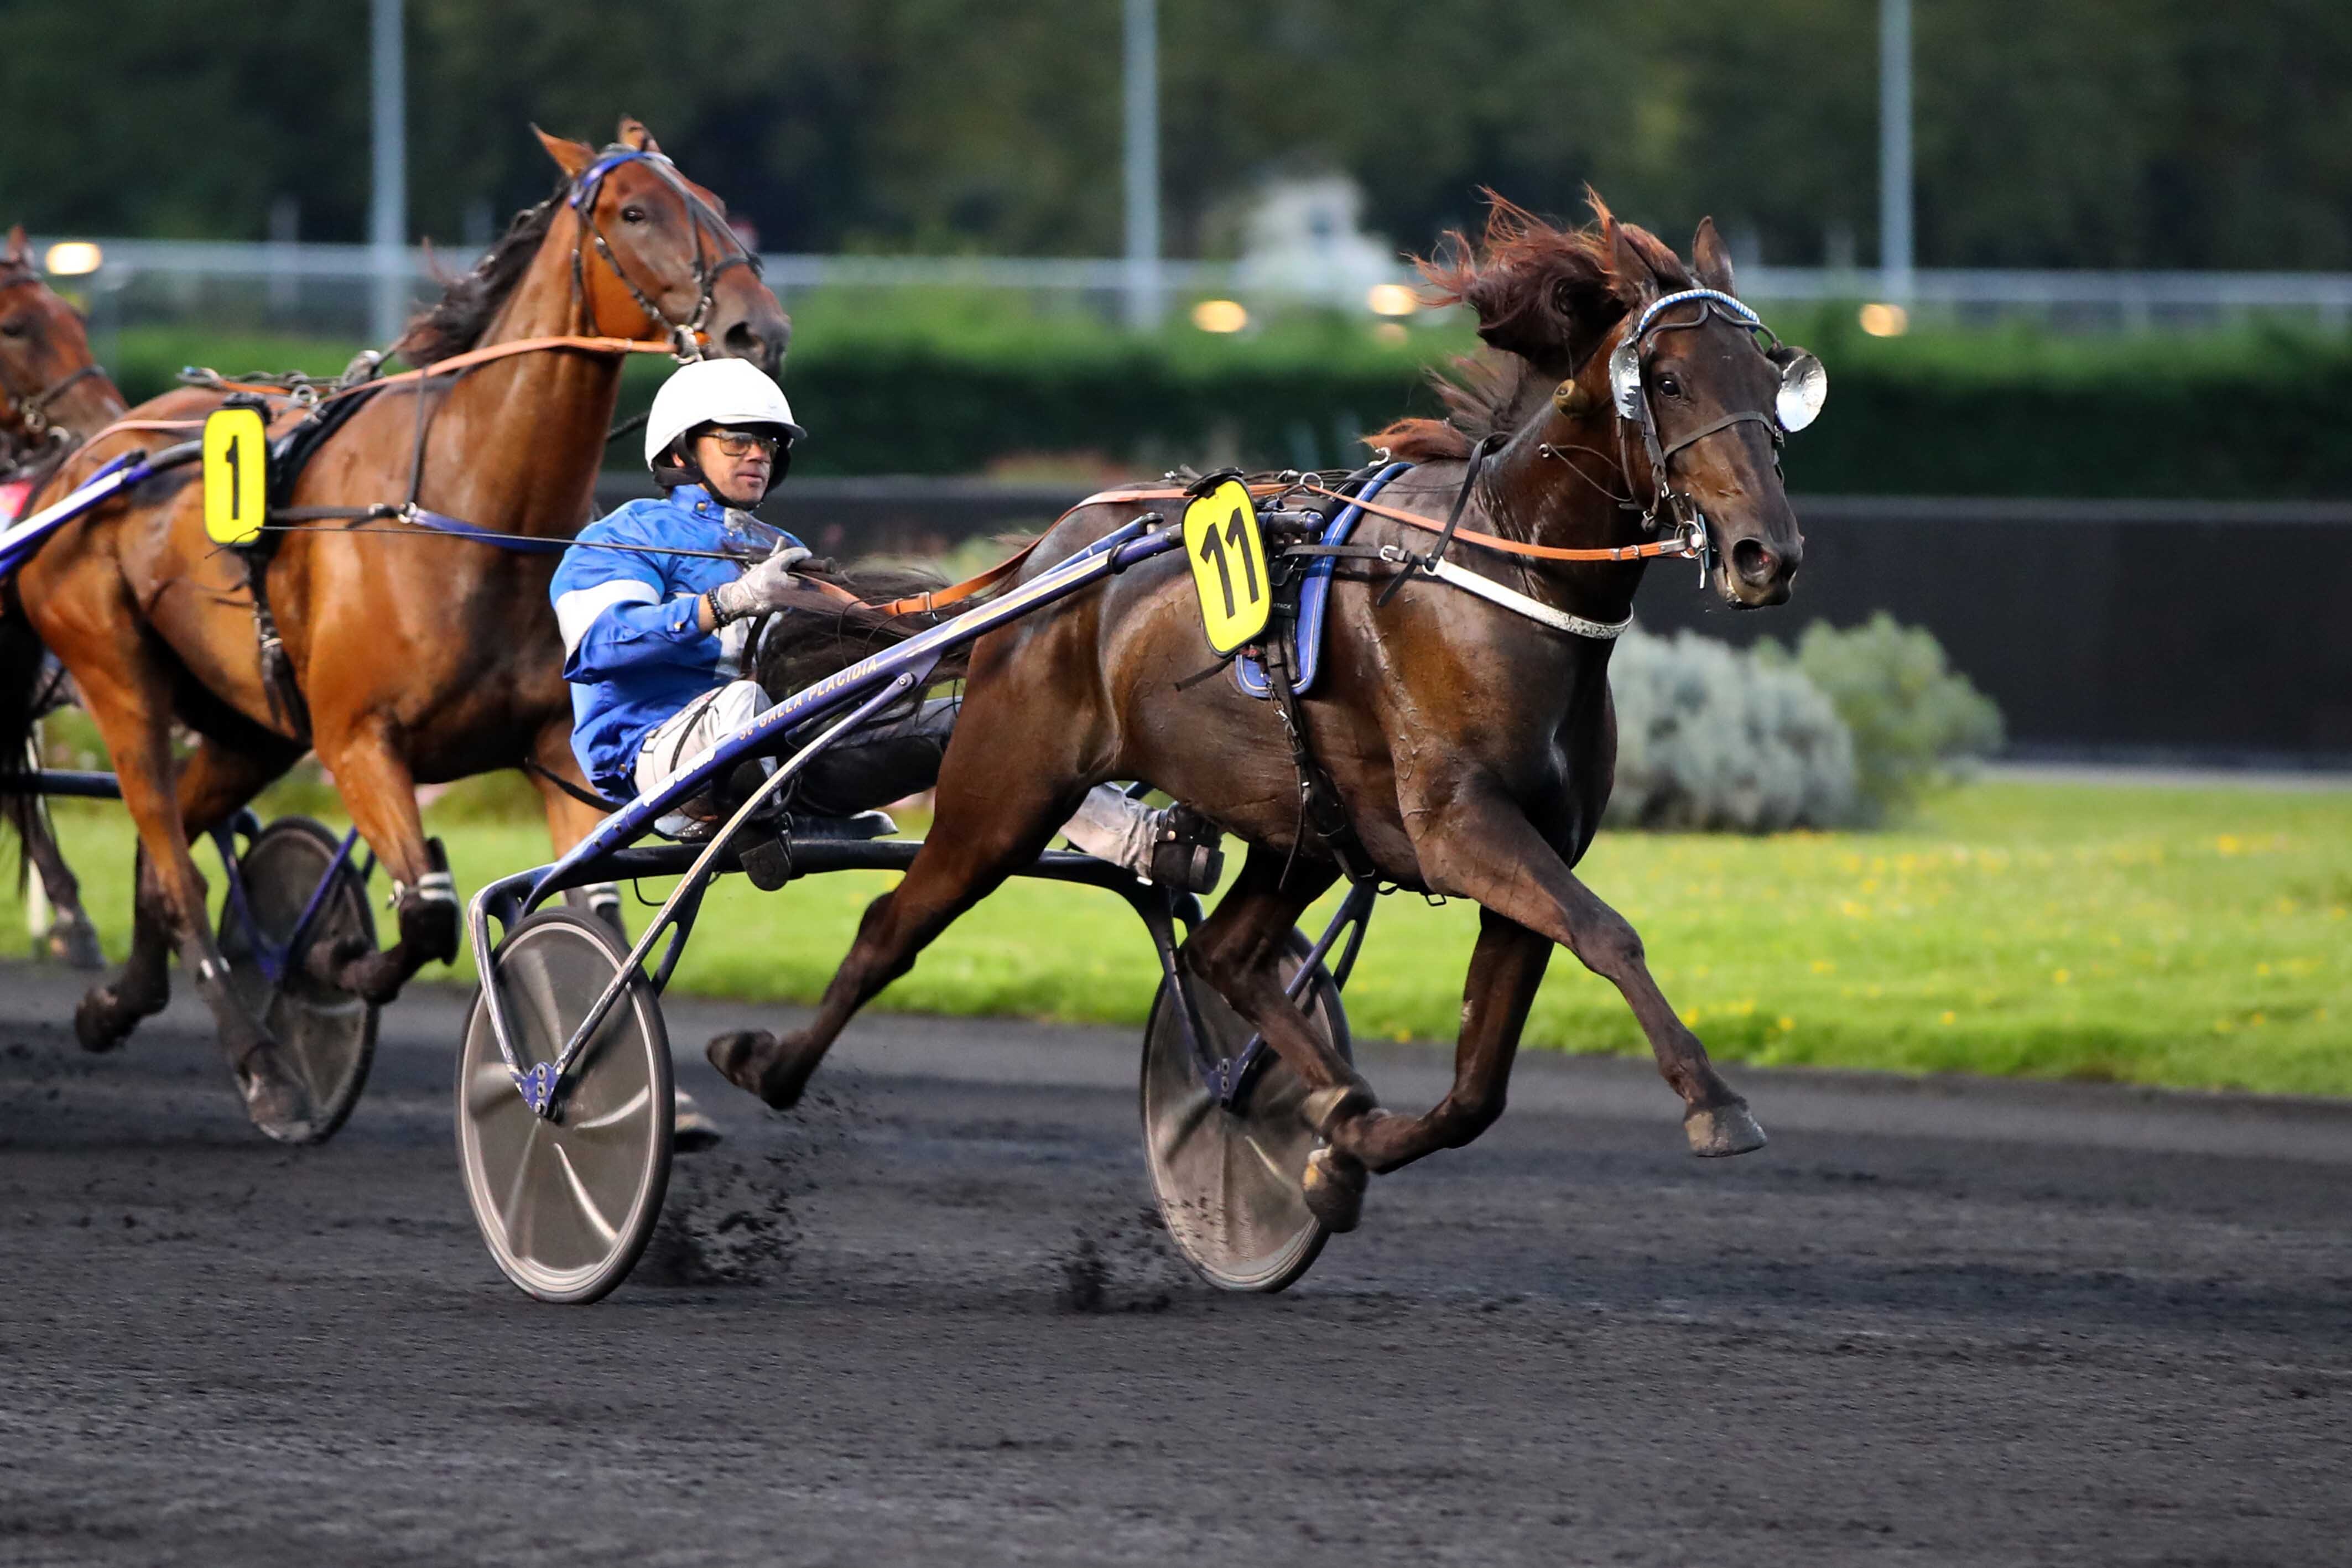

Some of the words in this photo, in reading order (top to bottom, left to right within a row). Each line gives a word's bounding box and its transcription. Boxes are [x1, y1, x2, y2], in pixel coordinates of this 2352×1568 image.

[226, 436, 239, 520] 1
[1200, 507, 1260, 619] 11
[758, 698, 803, 728] GALLA
[808, 658, 877, 701] PLACIDIA
